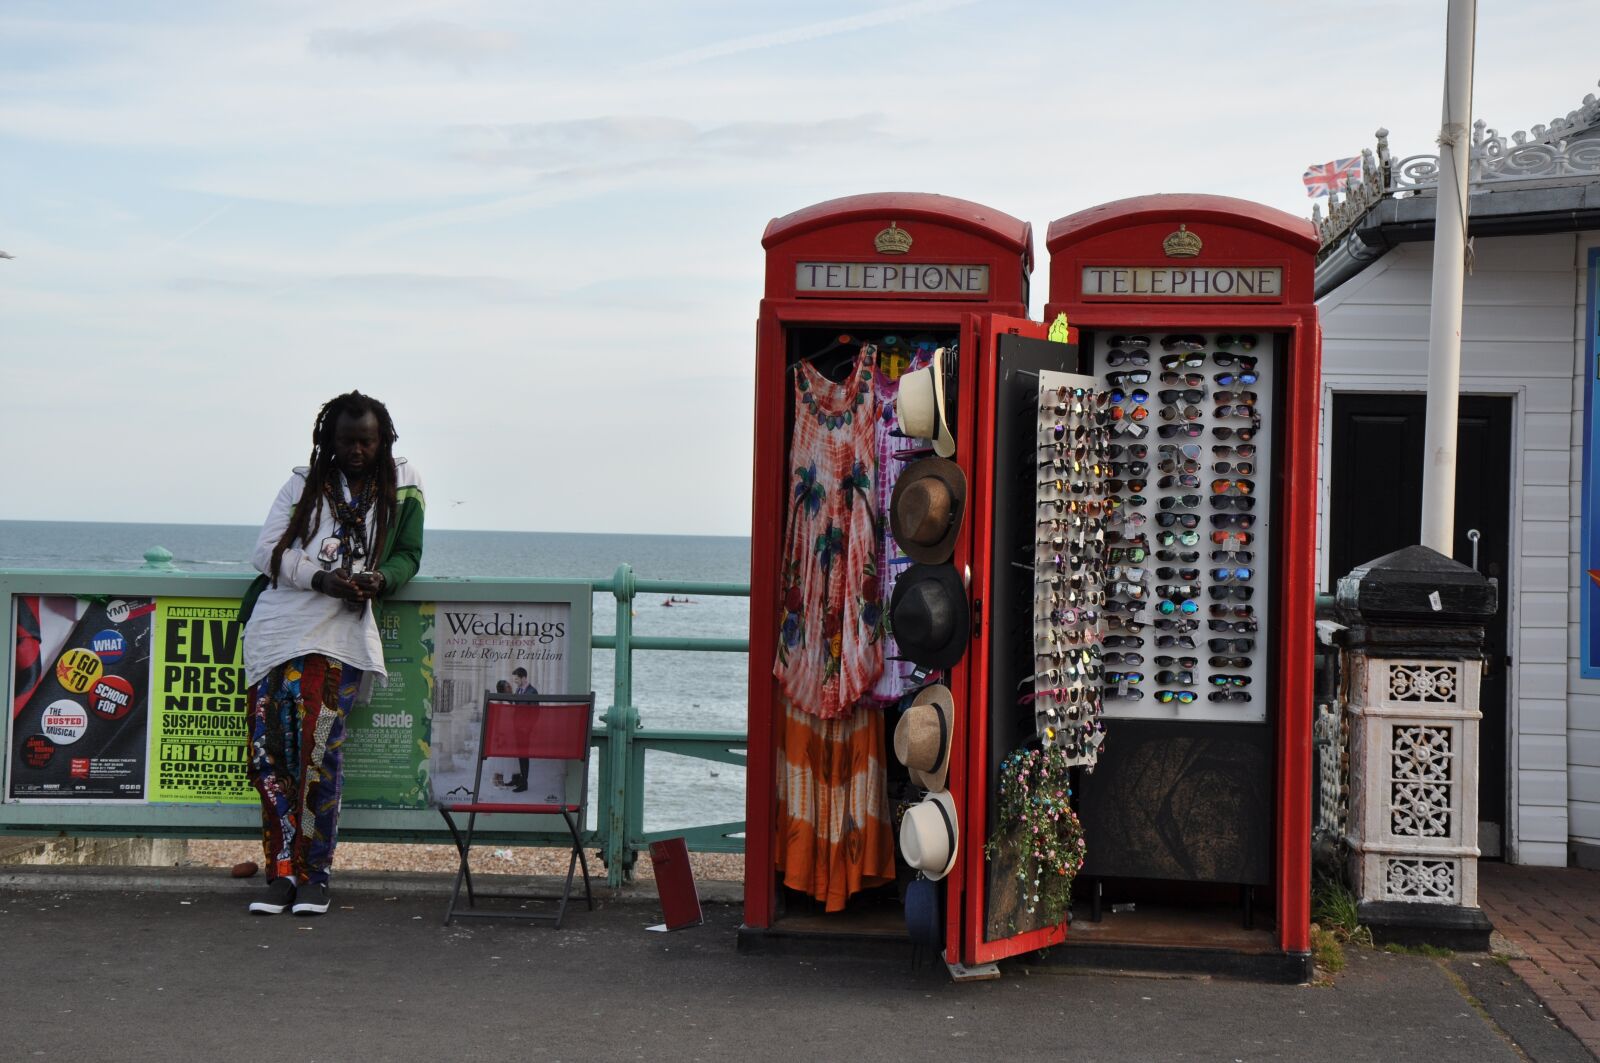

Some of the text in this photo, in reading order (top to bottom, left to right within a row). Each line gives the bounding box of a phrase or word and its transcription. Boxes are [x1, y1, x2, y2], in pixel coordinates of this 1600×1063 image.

[804, 264, 982, 290] TELEPHONE
[1091, 270, 1274, 294] TELEPHONE
[106, 604, 129, 618] YMT
[444, 612, 564, 644] Weddings
[94, 638, 122, 652] WHAT
[165, 618, 244, 664] ELV
[444, 646, 562, 662] at the Royal Pavilion
[70, 651, 99, 676] I GO
[72, 670, 88, 691] TO
[95, 682, 128, 706] SCHOOL
[50, 708, 62, 716] THE
[98, 700, 116, 714] FOR
[162, 714, 248, 729] SUSPICIOUSLY
[372, 710, 413, 728] suede
[46, 726, 76, 738] MUSICAL
[162, 744, 238, 761] FRI 19TH
